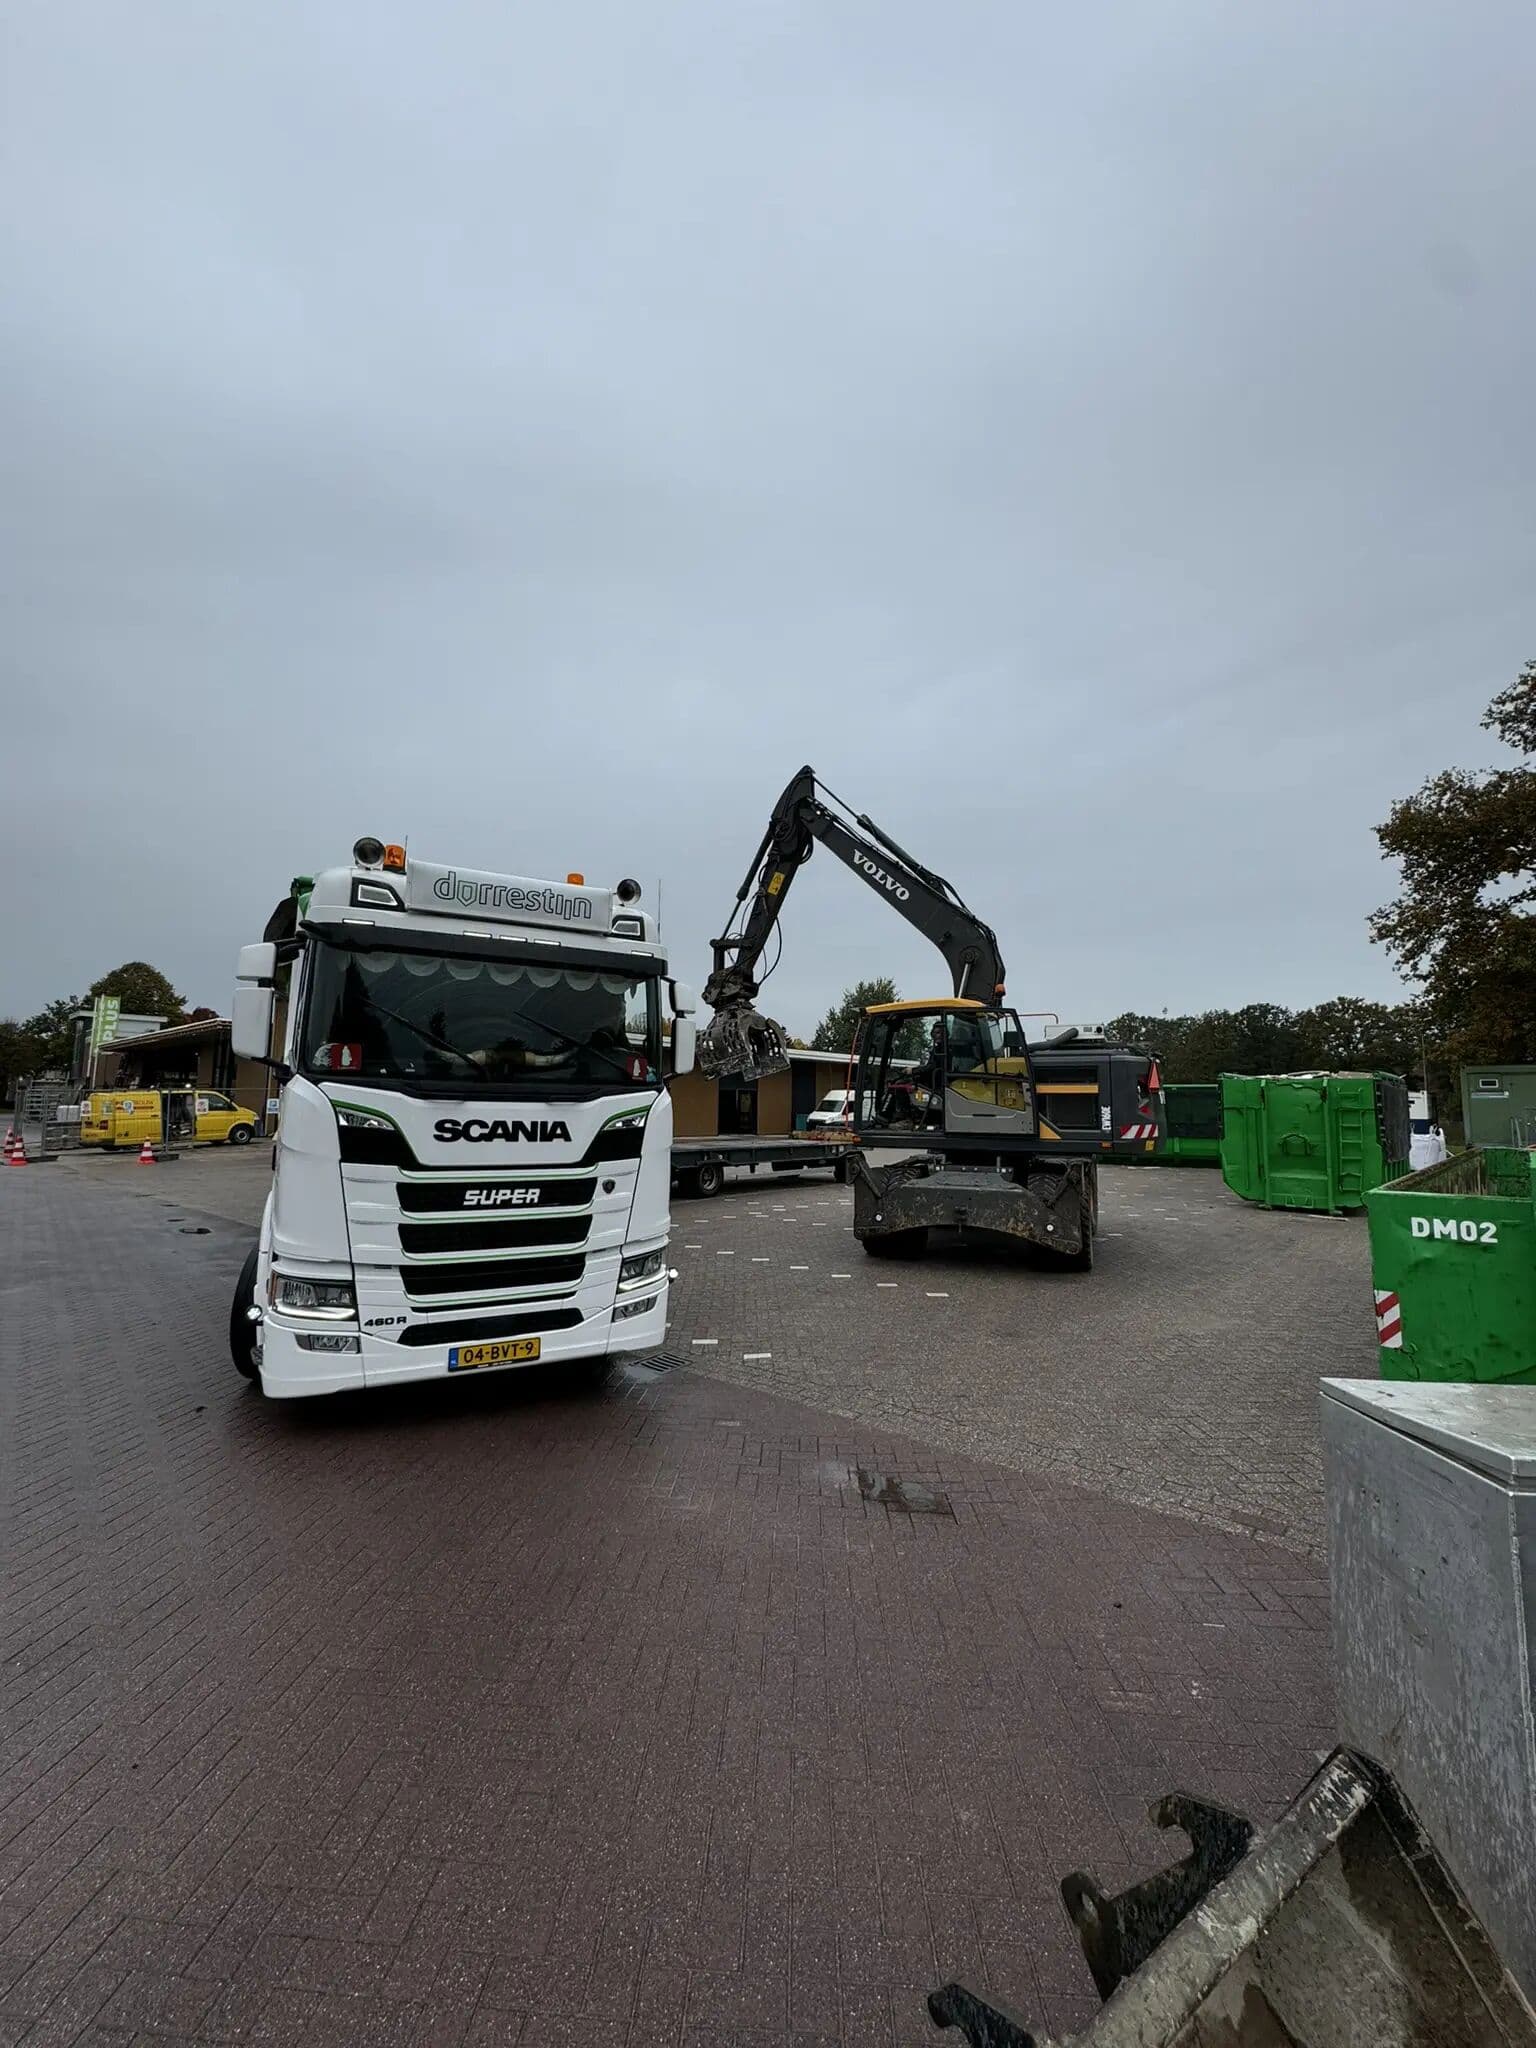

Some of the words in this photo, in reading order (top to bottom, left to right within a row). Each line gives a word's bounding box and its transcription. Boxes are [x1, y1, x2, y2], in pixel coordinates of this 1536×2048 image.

[853, 849, 910, 900] VOLVO
[102, 999, 119, 1041] PLUS
[433, 1118, 573, 1143] SCANIA
[463, 1188, 541, 1206] SUPER
[1411, 1216, 1499, 1243] DM02
[364, 1317, 395, 1326] 460
[396, 1316, 407, 1324] R
[463, 1341, 534, 1364] 04-BVT-9
